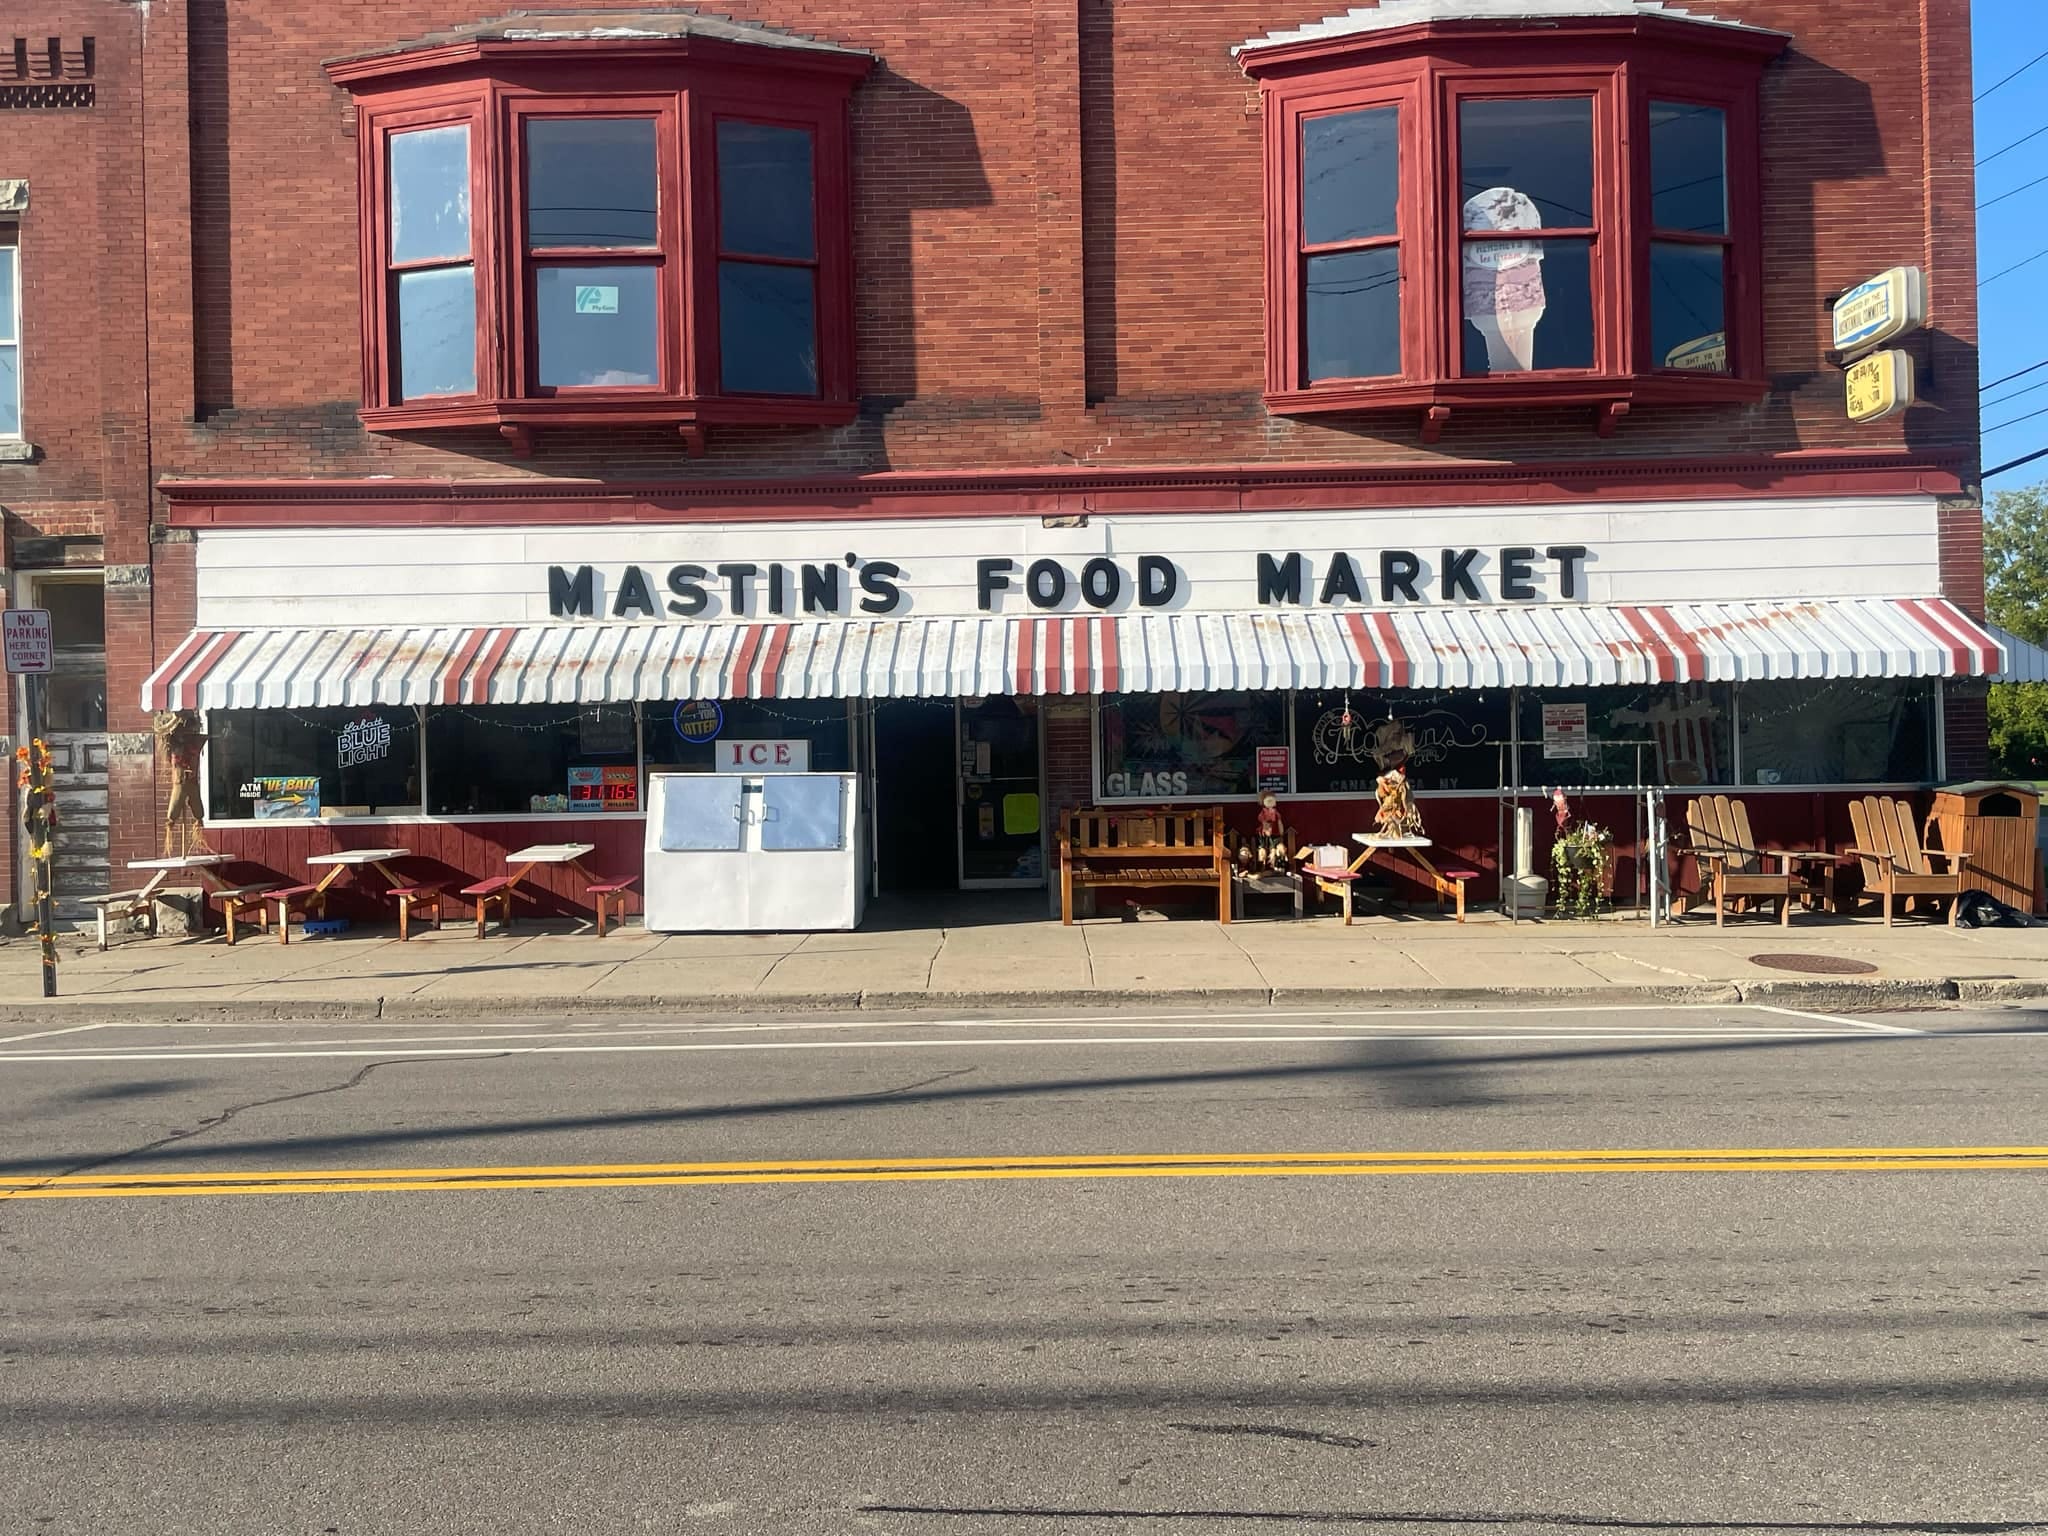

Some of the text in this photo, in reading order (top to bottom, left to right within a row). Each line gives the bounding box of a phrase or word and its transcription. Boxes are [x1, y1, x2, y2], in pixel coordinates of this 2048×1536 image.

[547, 545, 1587, 616] MASTIN'S FOOD MARKET
[17, 614, 35, 626] NO
[7, 627, 47, 640] PARKING
[9, 641, 46, 650] HERE TO
[12, 652, 46, 661] CORNER
[344, 717, 383, 731] Labatt
[338, 724, 390, 753] BLUE
[338, 741, 390, 768] LIGHT
[733, 743, 791, 766] ICE
[240, 784, 261, 792] ATM
[286, 779, 315, 791] BAIT
[1107, 771, 1187, 797] GLASS
[611, 784, 636, 800] 165
